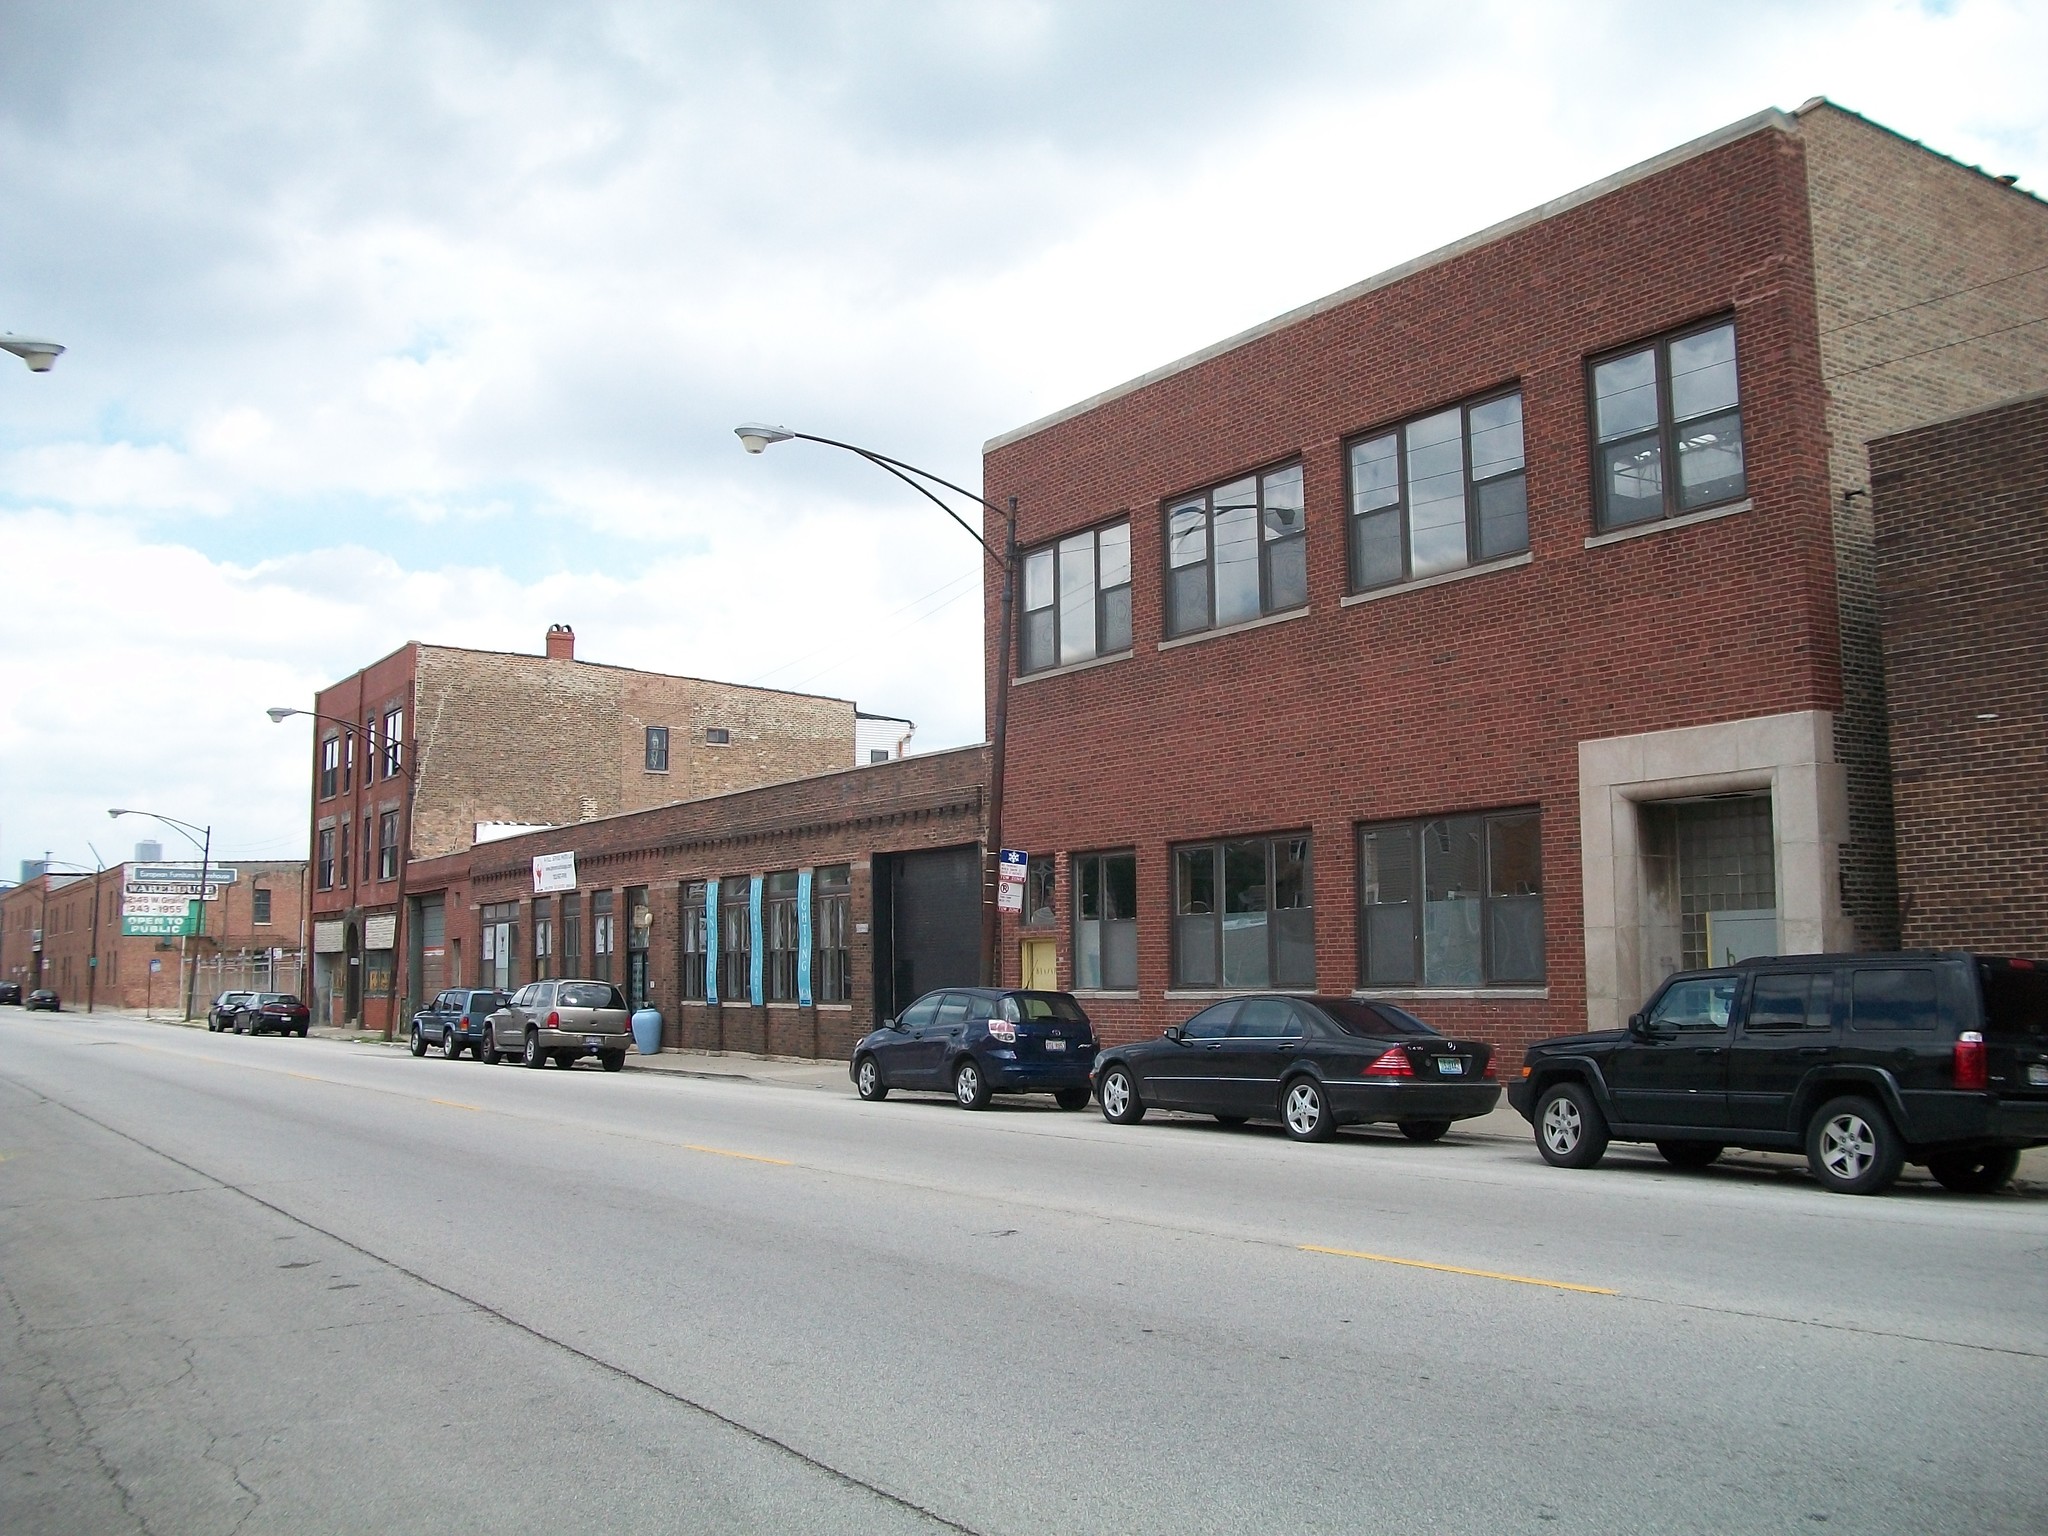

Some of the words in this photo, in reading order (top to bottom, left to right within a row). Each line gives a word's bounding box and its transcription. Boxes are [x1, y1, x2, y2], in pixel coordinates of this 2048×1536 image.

[140, 870, 168, 880] European
[170, 871, 195, 879] Furniture
[128, 916, 164, 925] OPEN
[167, 917, 184, 925] TO
[131, 925, 181, 933] PUBLIC
